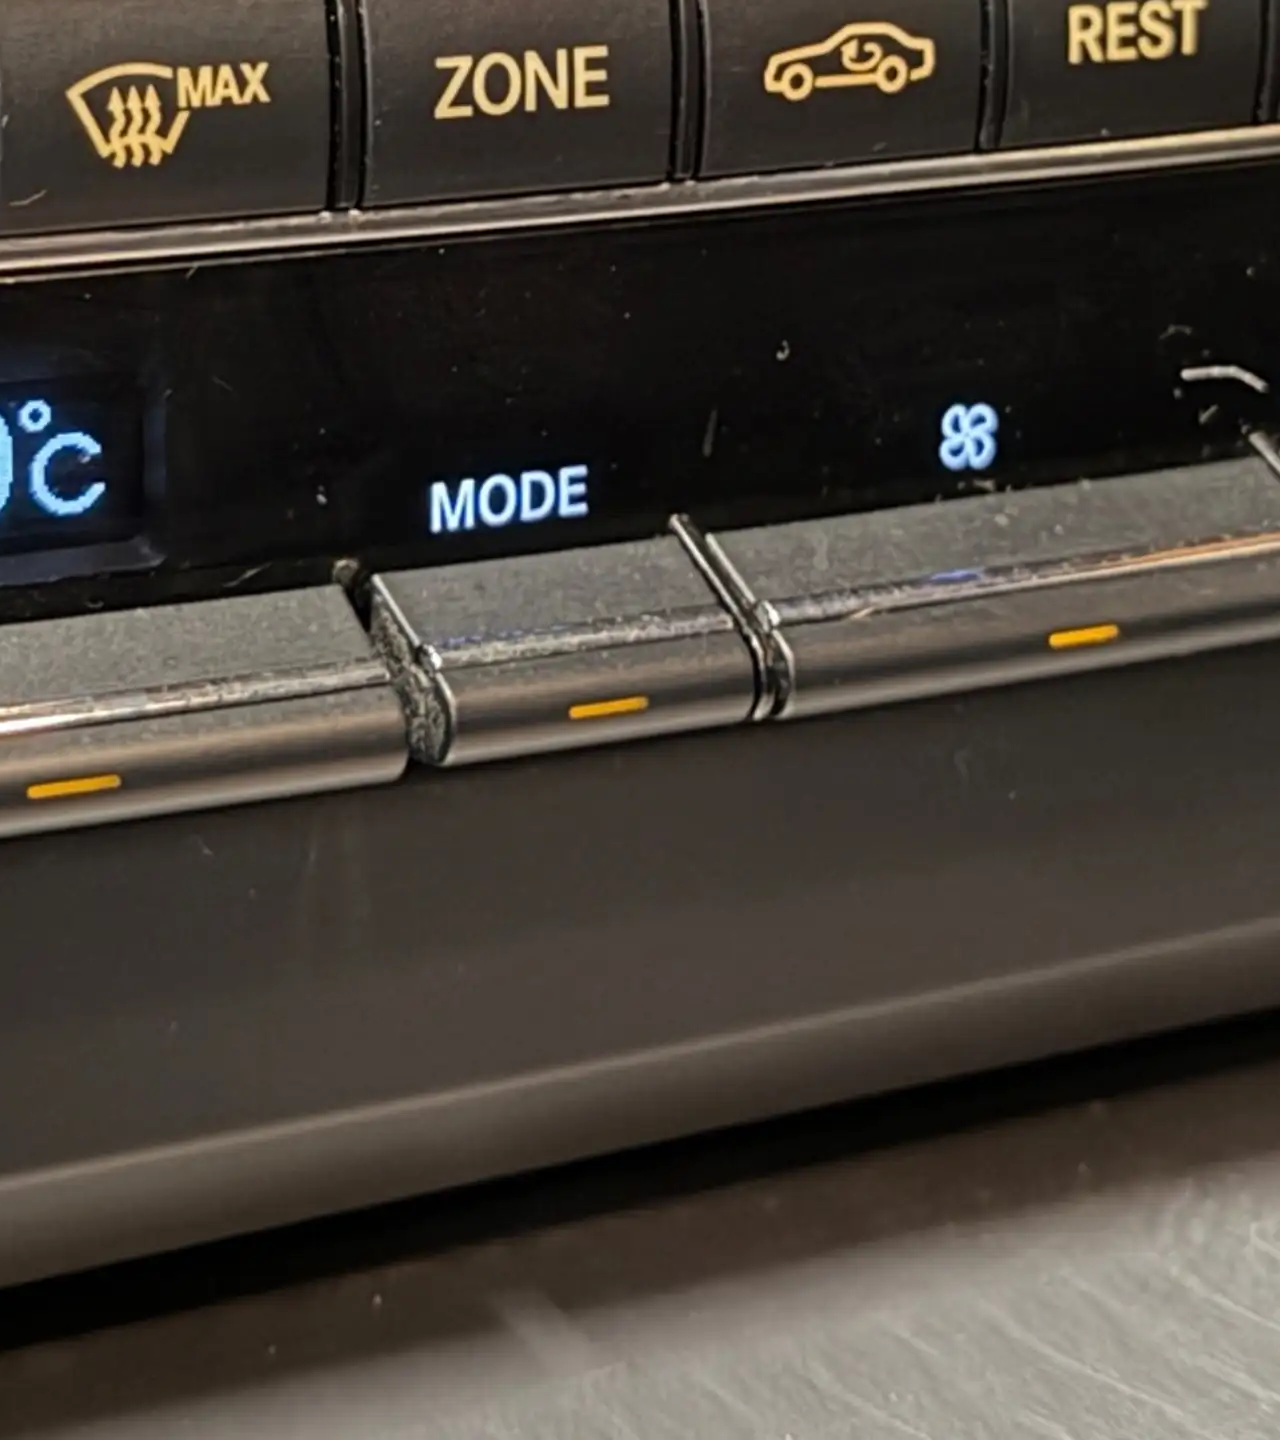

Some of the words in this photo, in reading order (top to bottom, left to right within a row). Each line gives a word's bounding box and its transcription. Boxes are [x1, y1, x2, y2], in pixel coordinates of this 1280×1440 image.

[177, 61, 270, 106] MAX
[434, 44, 610, 120] ZONE
[429, 464, 589, 534] MODE
